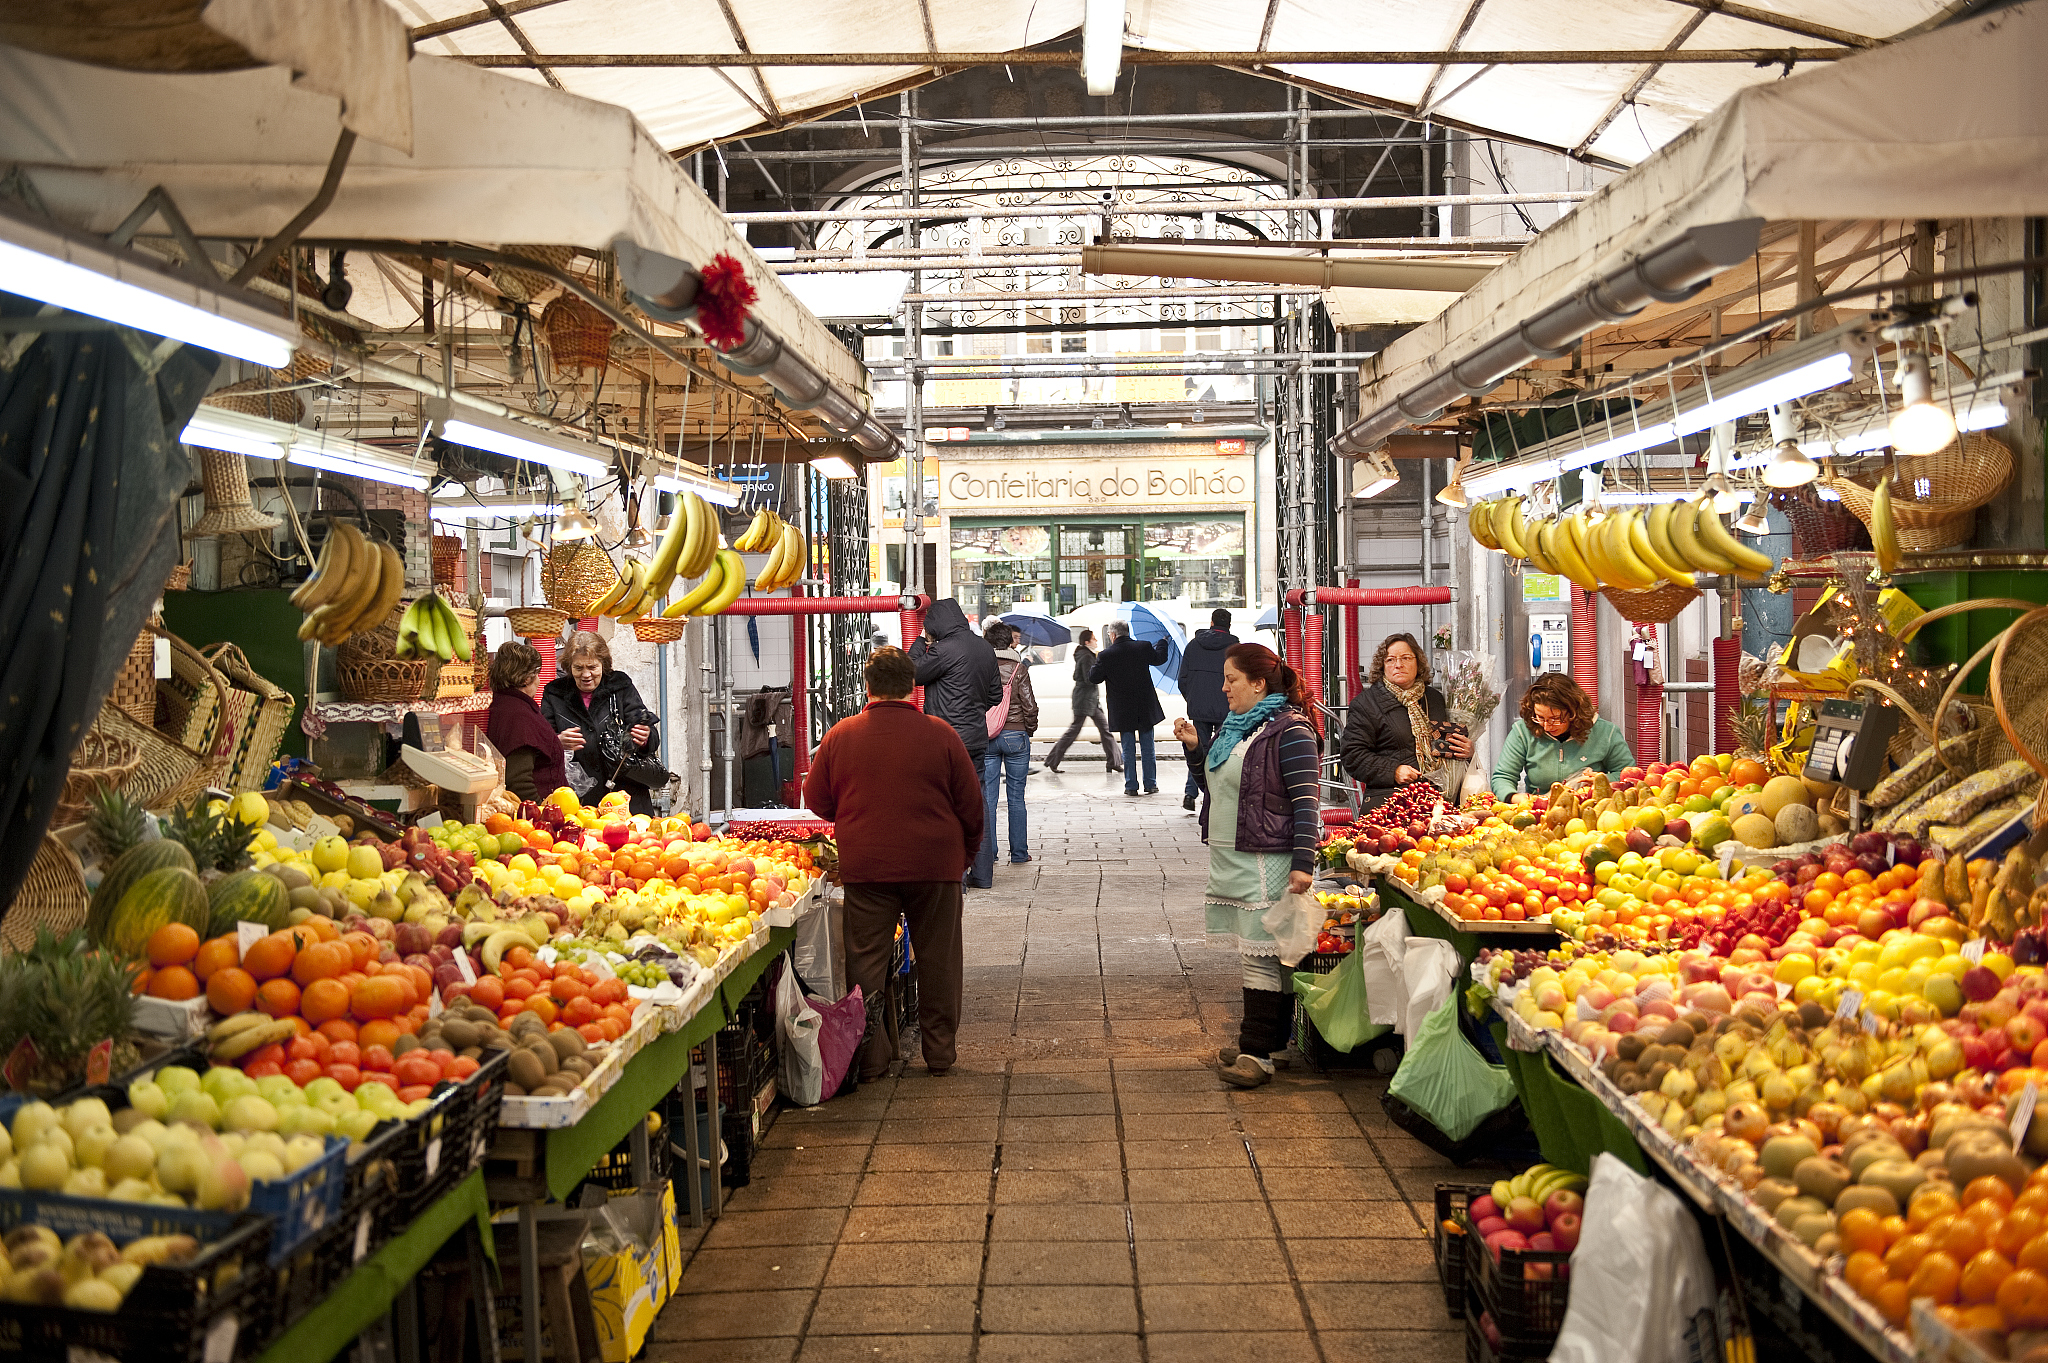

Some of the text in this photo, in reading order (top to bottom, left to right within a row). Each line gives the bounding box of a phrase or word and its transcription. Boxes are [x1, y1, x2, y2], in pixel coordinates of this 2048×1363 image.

[742, 483, 774, 491] BANCO
[949, 467, 1245, 500] Confeitaria do Bolhão
